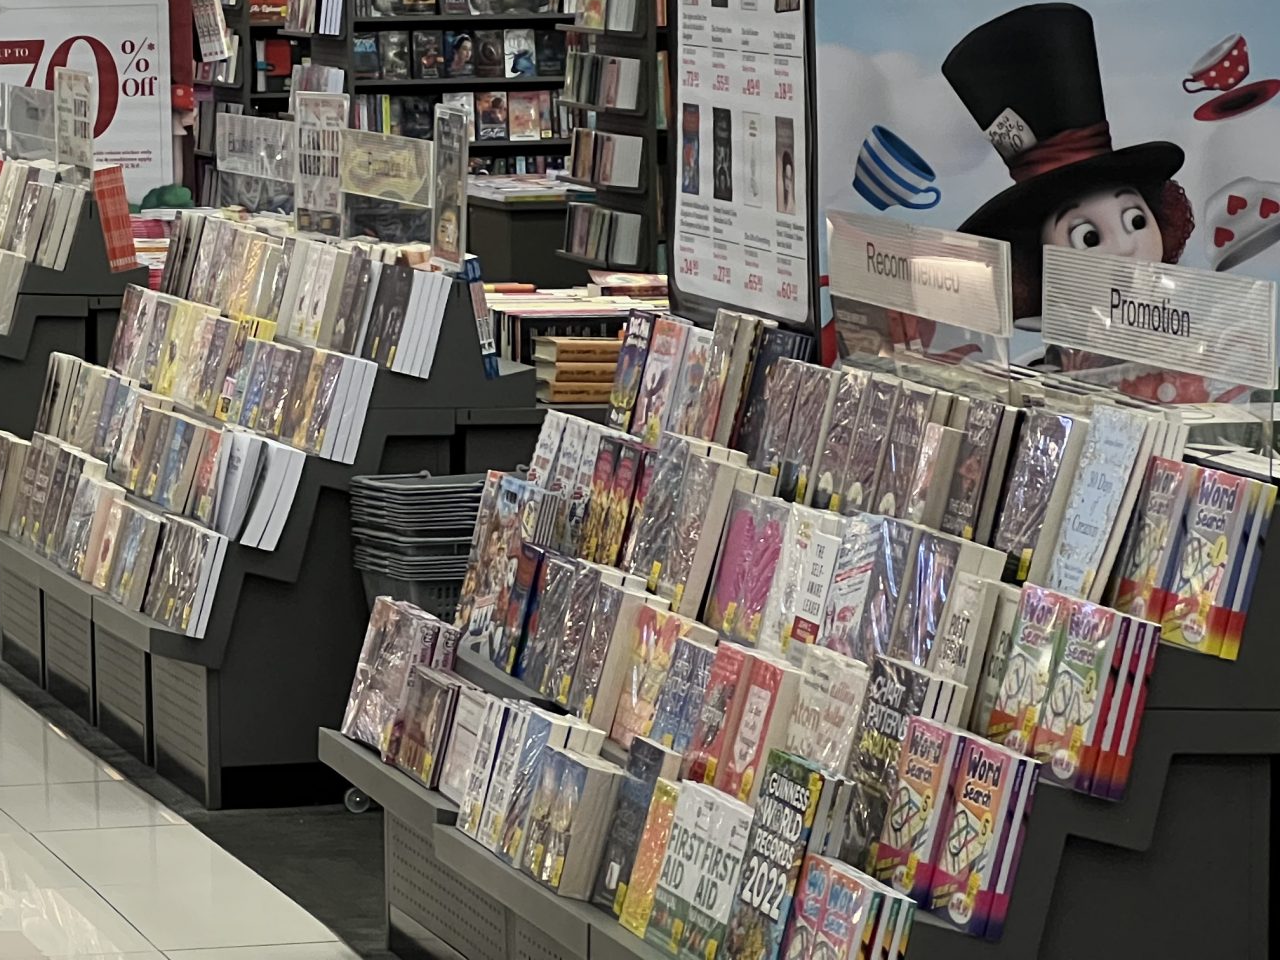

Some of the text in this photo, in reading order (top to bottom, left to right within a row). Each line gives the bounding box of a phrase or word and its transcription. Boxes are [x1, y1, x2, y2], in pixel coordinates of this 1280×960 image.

[14, 47, 29, 57] TO
[122, 76, 157, 97] Off
[865, 242, 961, 295] Recommended
[1110, 288, 1192, 338] Promotion
[1198, 476, 1240, 513] Word
[1195, 510, 1229, 533] Search
[872, 675, 907, 709] CHART
[866, 698, 910, 742] PATTERNS
[907, 723, 946, 765] Word
[968, 745, 1004, 788] Word
[769, 772, 811, 812] GUINNESS
[961, 783, 993, 808] Search
[668, 822, 704, 866] FIRST
[701, 841, 740, 886] FIRST
[754, 828, 795, 870] RECORDS
[662, 854, 685, 890] AID
[740, 855, 788, 922] 2022
[693, 874, 719, 912] AID
